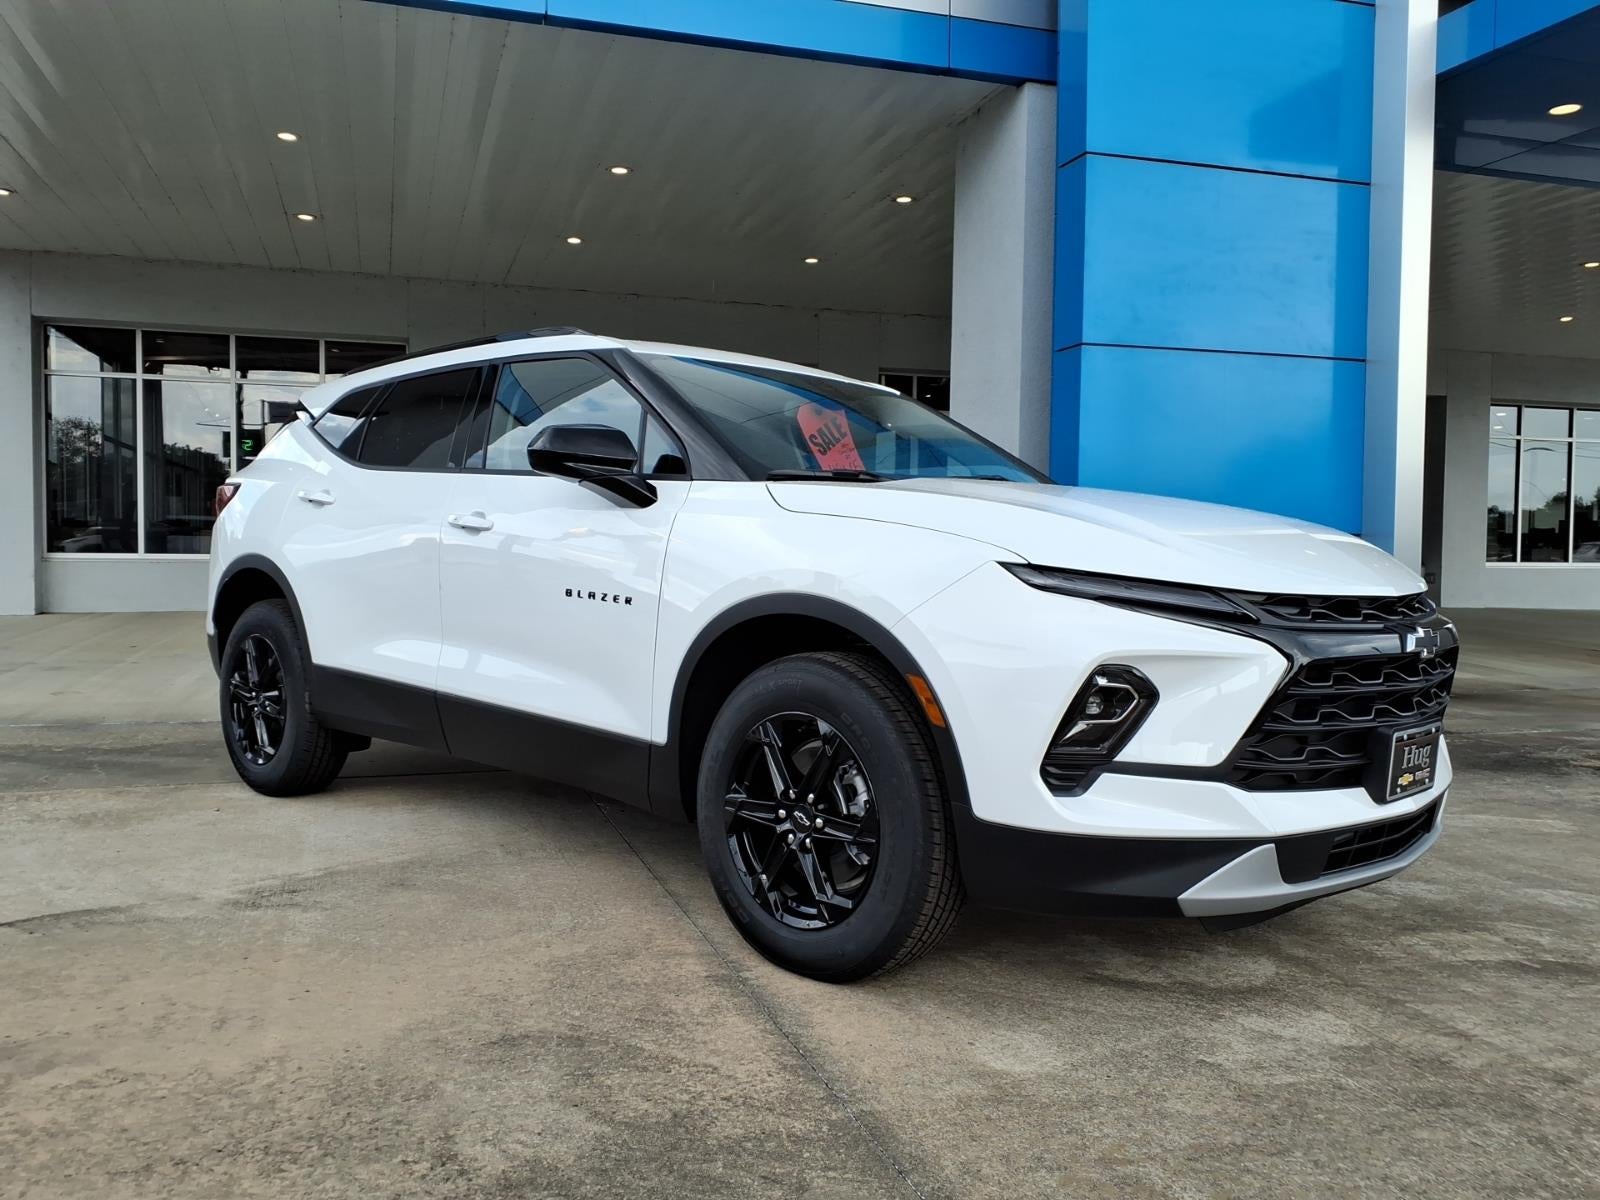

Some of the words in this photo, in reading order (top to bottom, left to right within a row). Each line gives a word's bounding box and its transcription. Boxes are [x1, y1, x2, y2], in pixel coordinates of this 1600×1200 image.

[808, 416, 848, 456] SALE
[565, 588, 633, 606] BLAZER
[1402, 745, 1432, 769] Hug
